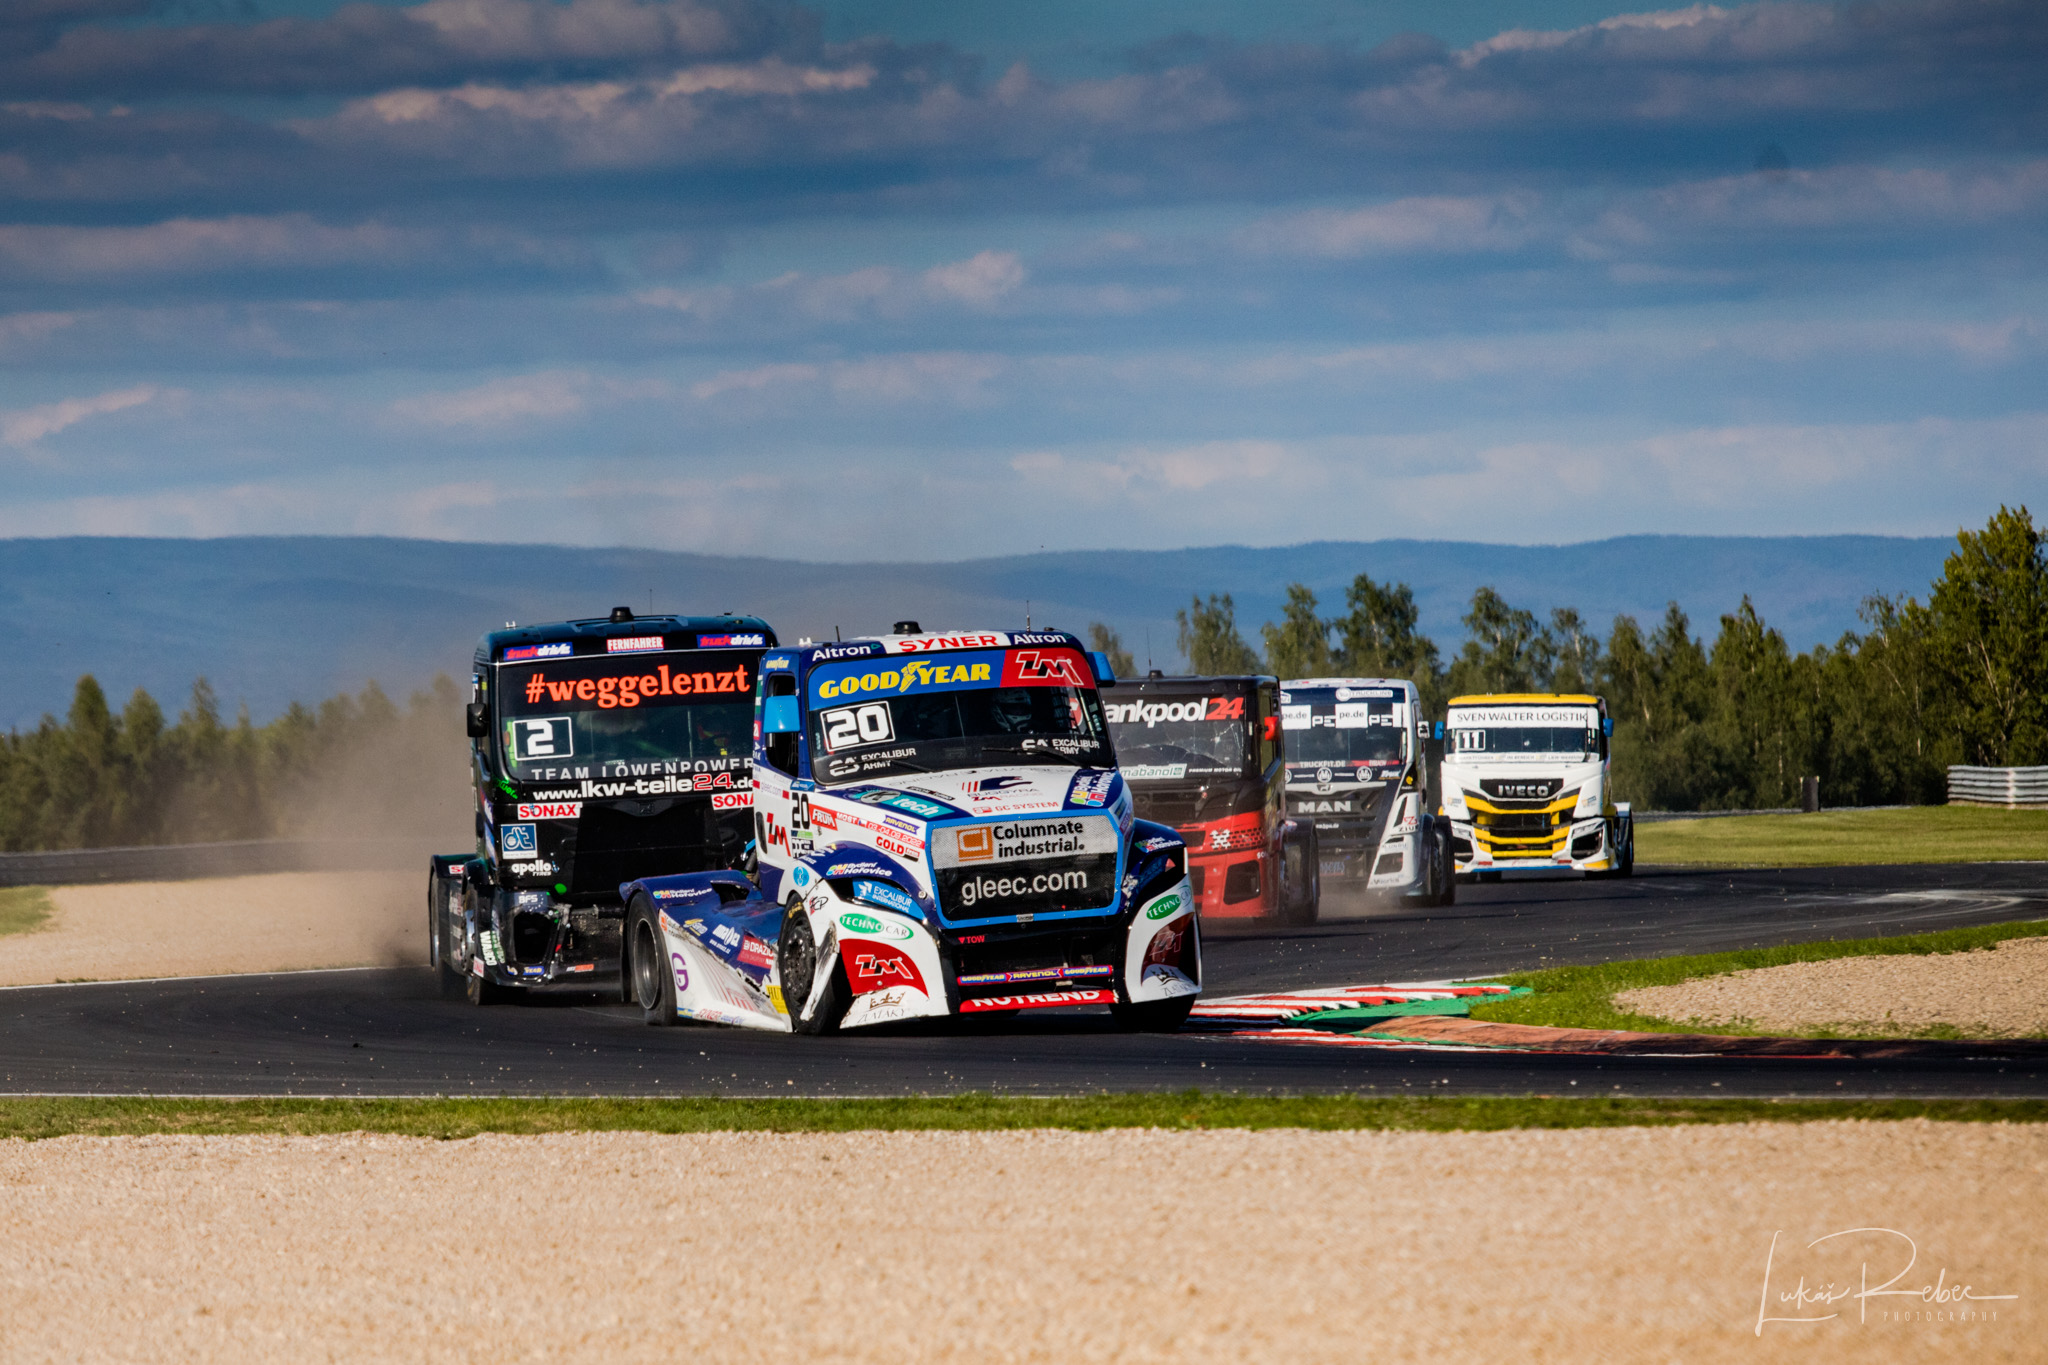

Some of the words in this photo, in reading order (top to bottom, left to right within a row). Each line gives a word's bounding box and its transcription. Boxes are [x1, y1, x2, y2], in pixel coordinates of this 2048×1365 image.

[607, 636, 664, 651] FERNFAHRER
[899, 635, 998, 652] SYNER
[1013, 632, 1067, 645] Altron
[812, 643, 871, 662] Altron
[526, 664, 751, 709] #weggelenzt
[818, 660, 991, 699] GOODYEAR
[1339, 710, 1365, 720] pe.de
[1457, 712, 1486, 722] SVEN
[1489, 711, 1534, 722] WALTER
[1536, 711, 1588, 722] LOGISTIK
[826, 705, 890, 747] 20
[526, 719, 555, 756] 2
[1052, 738, 1100, 750] EXCALIBUR
[1462, 731, 1481, 749] 11
[861, 747, 917, 761] EXCALIBUR
[531, 766, 590, 780] TEAM
[863, 759, 892, 771] ARMY
[967, 788, 1040, 798] BUGGYRA
[1498, 785, 1550, 797] IVECO
[519, 803, 577, 819] SONAX
[791, 792, 811, 829] 20
[893, 796, 940, 817] tech
[1013, 800, 1059, 810] SYSTEM
[1298, 801, 1352, 813] MAN
[811, 808, 836, 828] FRUM
[993, 820, 1084, 840] Columnate
[876, 836, 905, 855] GOLD
[511, 859, 552, 875] apollo
[961, 870, 1088, 907] gleec.com
[518, 894, 539, 904] BFS
[873, 885, 913, 909] EXCALIBUR
[966, 935, 985, 944] TOW
[1013, 970, 1057, 979] RAVENOL
[973, 990, 1101, 1008] NUTREND
